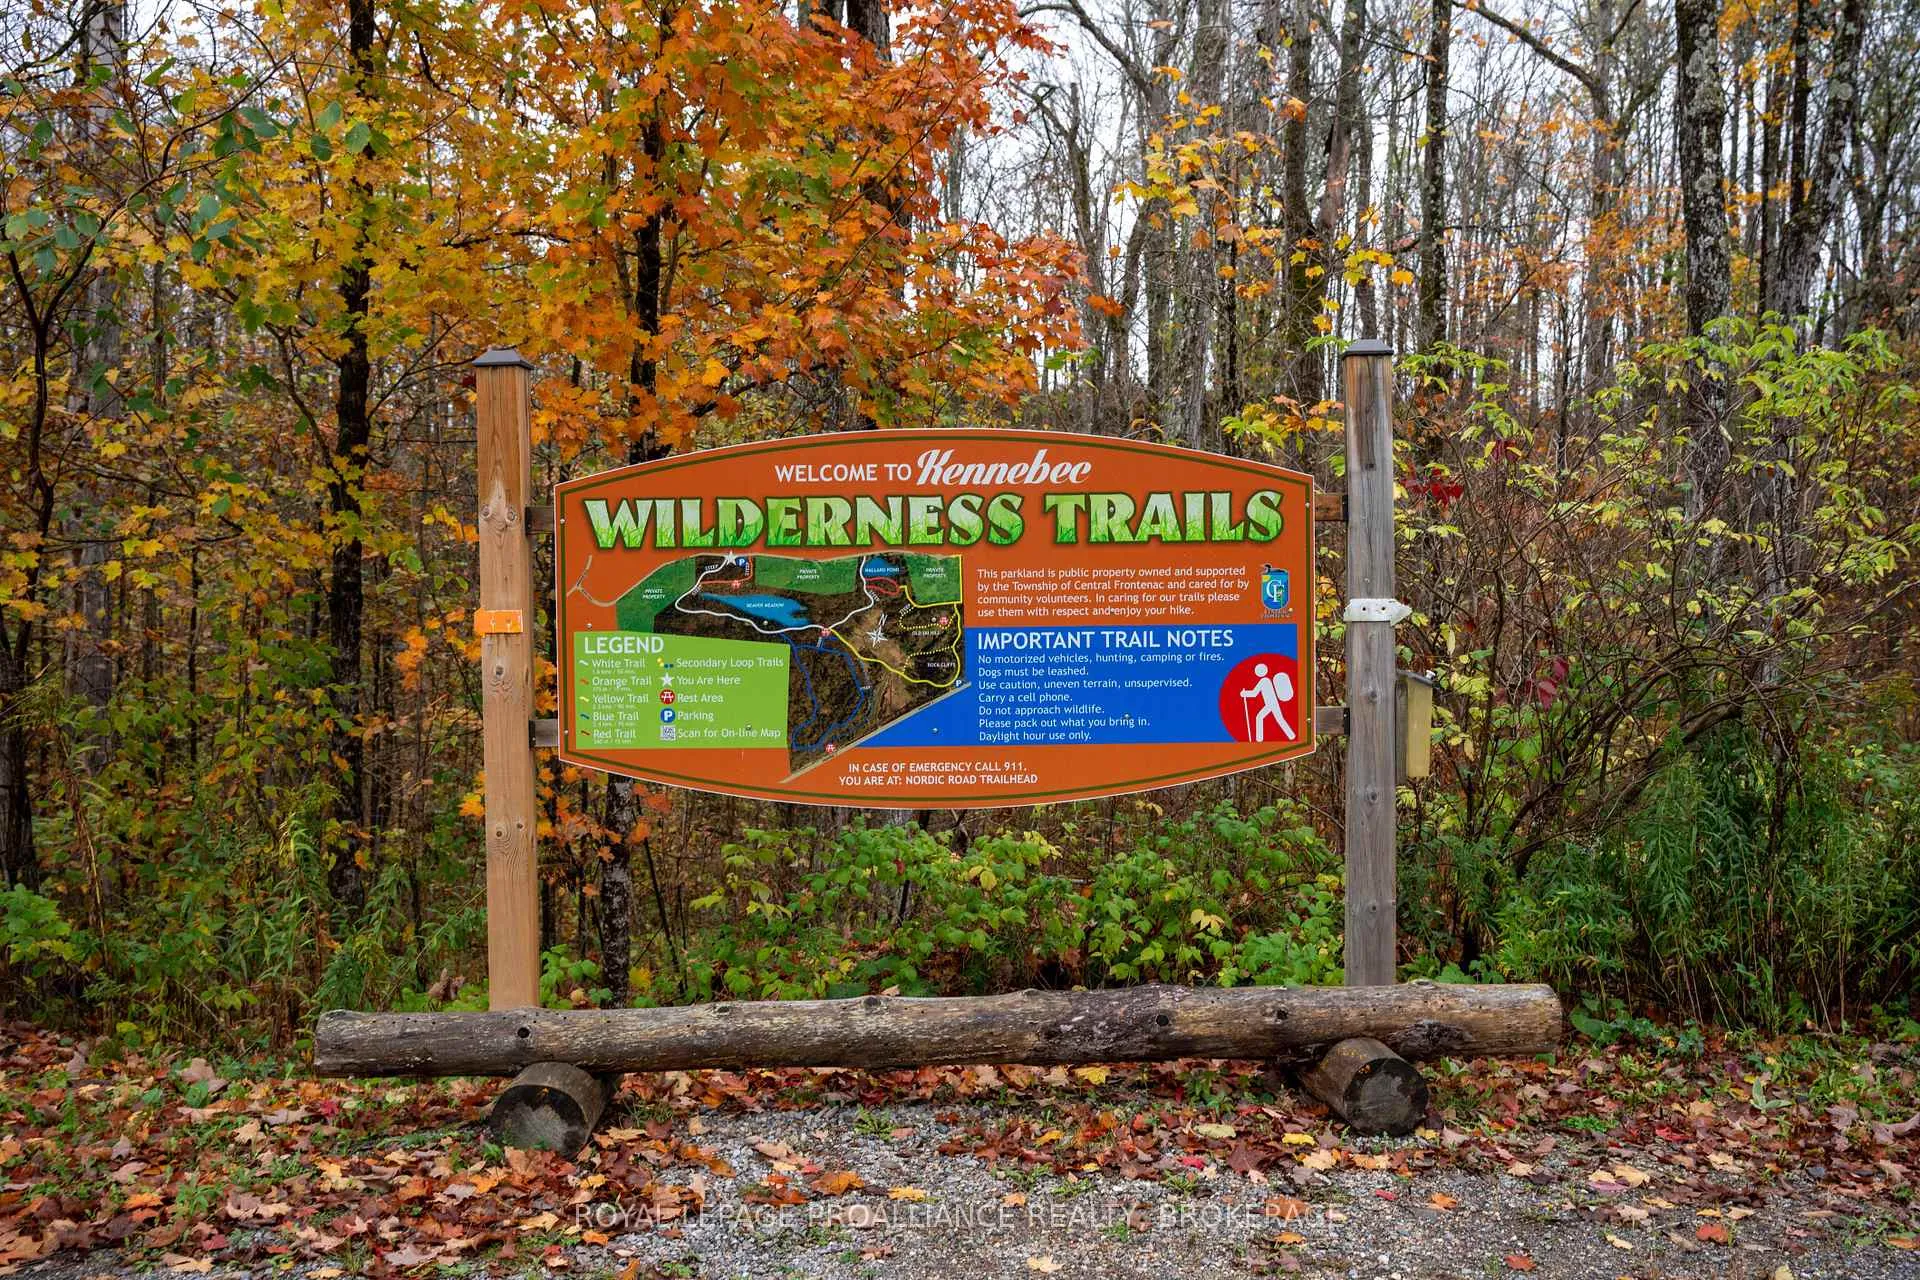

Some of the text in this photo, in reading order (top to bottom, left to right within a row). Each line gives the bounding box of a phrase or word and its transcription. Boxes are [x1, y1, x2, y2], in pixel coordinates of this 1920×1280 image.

[775, 448, 1091, 486] WELCOME TO Kennebec
[583, 489, 1284, 549] WILDERNESS TRAILS
[977, 566, 1245, 580] This parkland is public property owned and supported
[977, 579, 1249, 593] by the Township of Central Frontenac and cared for by
[977, 592, 1240, 606] community volunteers. In caring for our trails please
[978, 606, 1194, 618] use them with respect and enjoy your hike.
[584, 636, 664, 654] LEGEND
[978, 630, 1234, 650] IMPORTANT TRAIL NOTES
[592, 658, 646, 668] White Trail
[676, 657, 784, 669] Secondary Loop Trails
[978, 655, 992, 664] No
[995, 654, 1045, 664] motorized
[1048, 654, 1092, 664] vehicles,
[1096, 653, 1136, 664] hunting,
[1140, 652, 1182, 664] camping
[1200, 652, 1224, 660] fires.
[978, 666, 1088, 678] Dogs must be leashed.
[592, 676, 652, 688] Orange Trail
[676, 676, 741, 684] You Are Here
[978, 680, 996, 690] Use
[1084, 680, 1120, 688] terrain,
[1124, 678, 1192, 690] unsupervised.
[592, 694, 648, 704] Yellow Trail
[677, 694, 724, 702] Rest Area
[978, 694, 1006, 704] Carry
[1018, 692, 1036, 702] cell
[1040, 692, 1073, 703] phone.
[593, 712, 639, 720] Blue Trail
[978, 704, 1104, 716] Do not approach wildlife.
[678, 711, 714, 722] Parking
[979, 716, 1150, 729] Please pack out what you bring in.
[593, 730, 636, 738] Red Trail
[678, 728, 780, 739] Scan for On-line Map
[980, 730, 1092, 742] Daylight hour use only.
[848, 762, 1026, 772] IN CASE OF EMERGENCY CALL 911.
[840, 774, 1038, 786] YOU ARE AT: NORDIC ROAD TRAILHEAD
